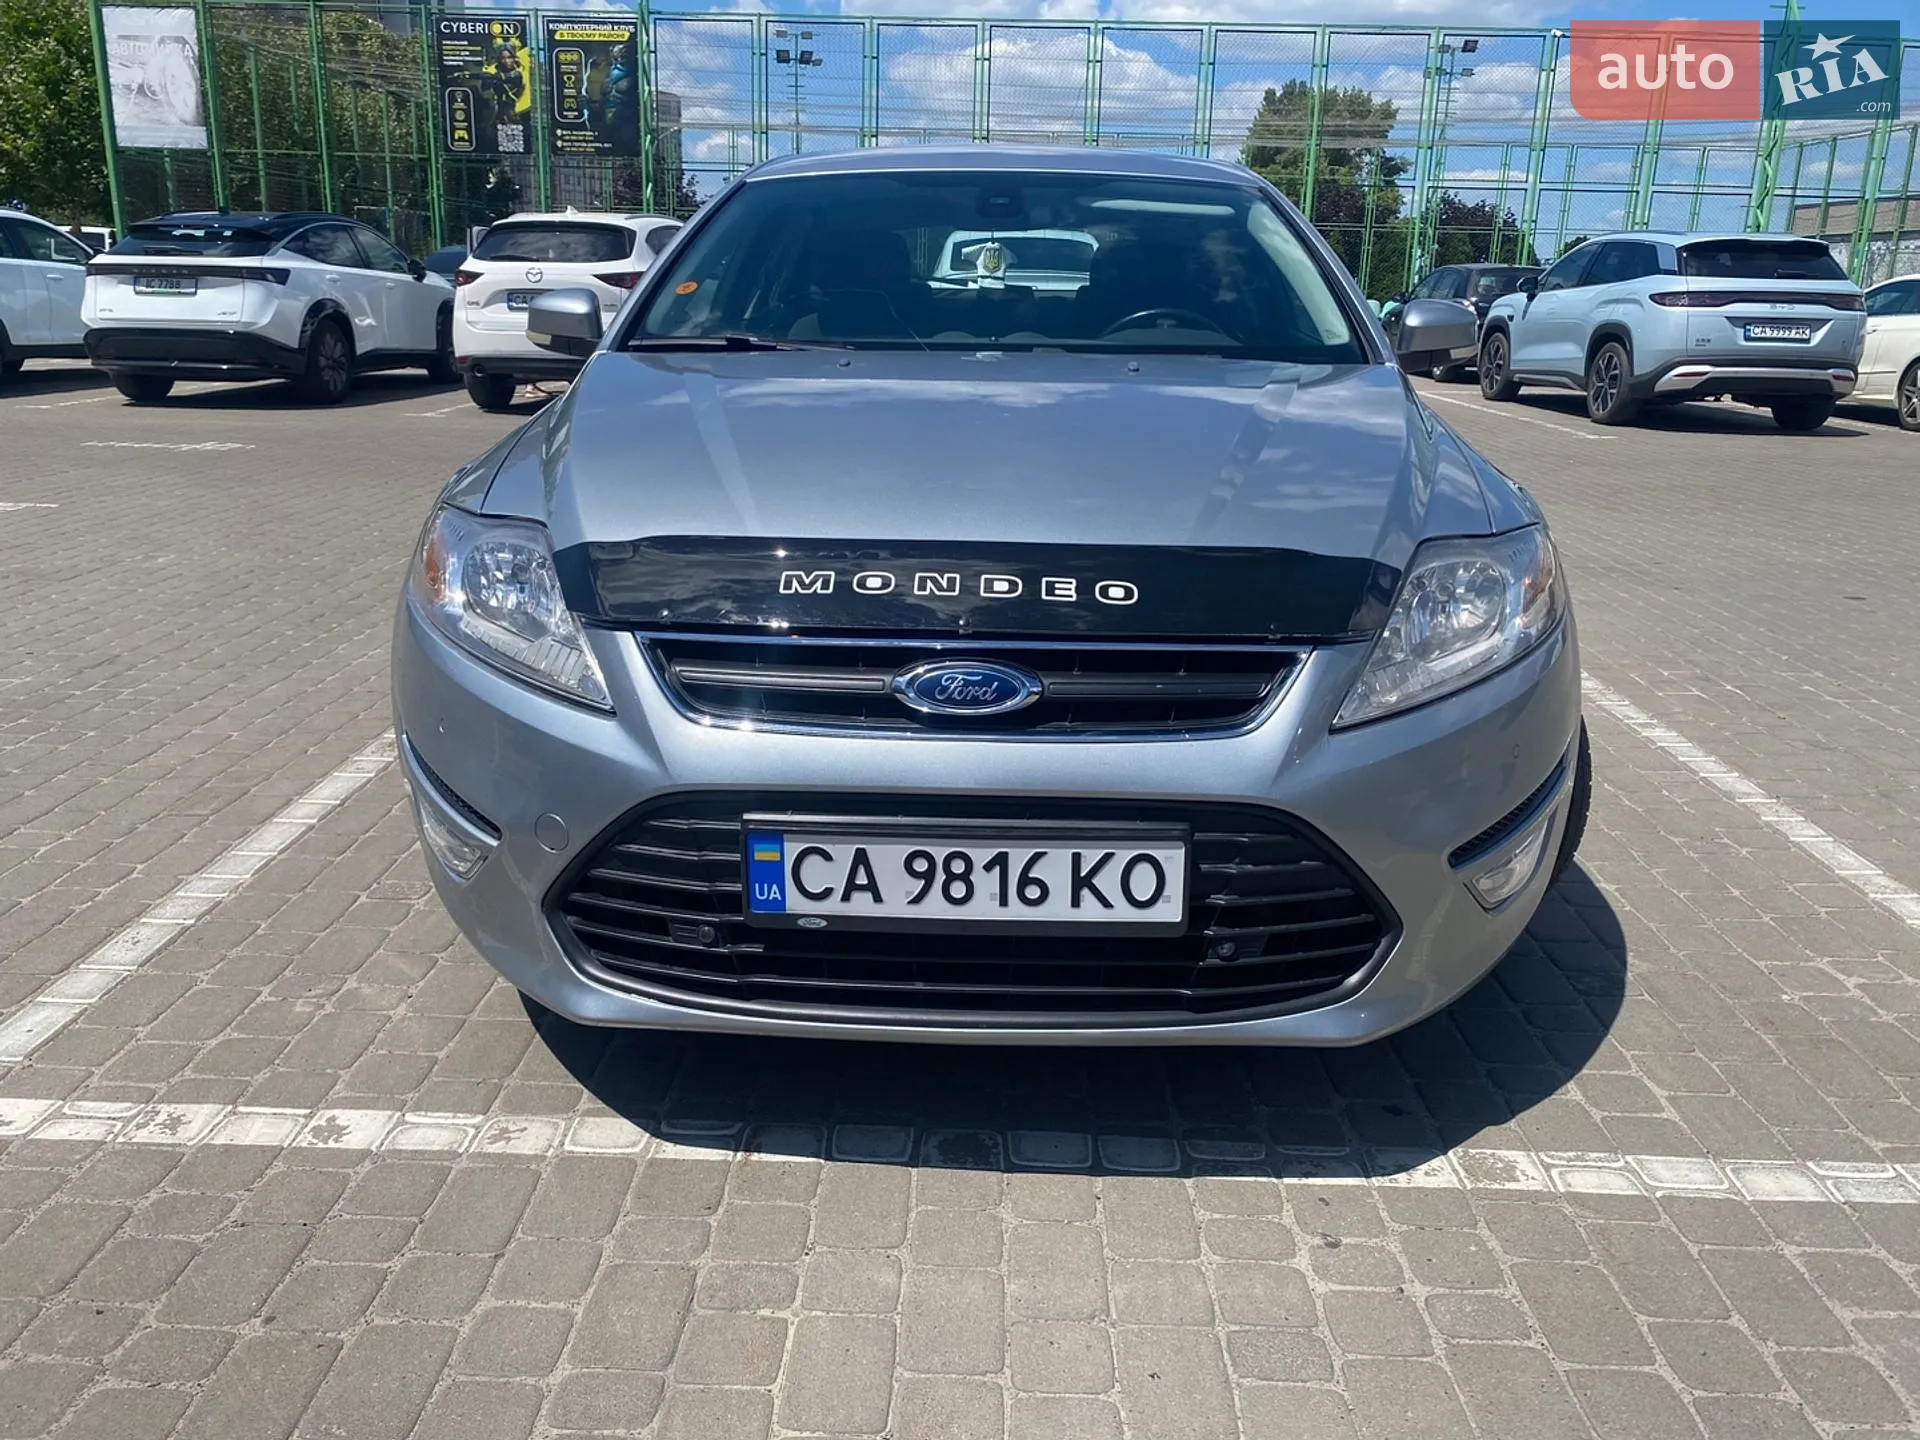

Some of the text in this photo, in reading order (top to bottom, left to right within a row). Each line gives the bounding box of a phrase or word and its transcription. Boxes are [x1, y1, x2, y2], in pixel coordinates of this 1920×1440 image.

[440, 21, 514, 34] CYBERION
[1752, 325, 1767, 336] CA
[779, 570, 1139, 606] MONDEO
[934, 672, 998, 702] Ford
[755, 845, 1167, 910] UA CA 9816 KO
